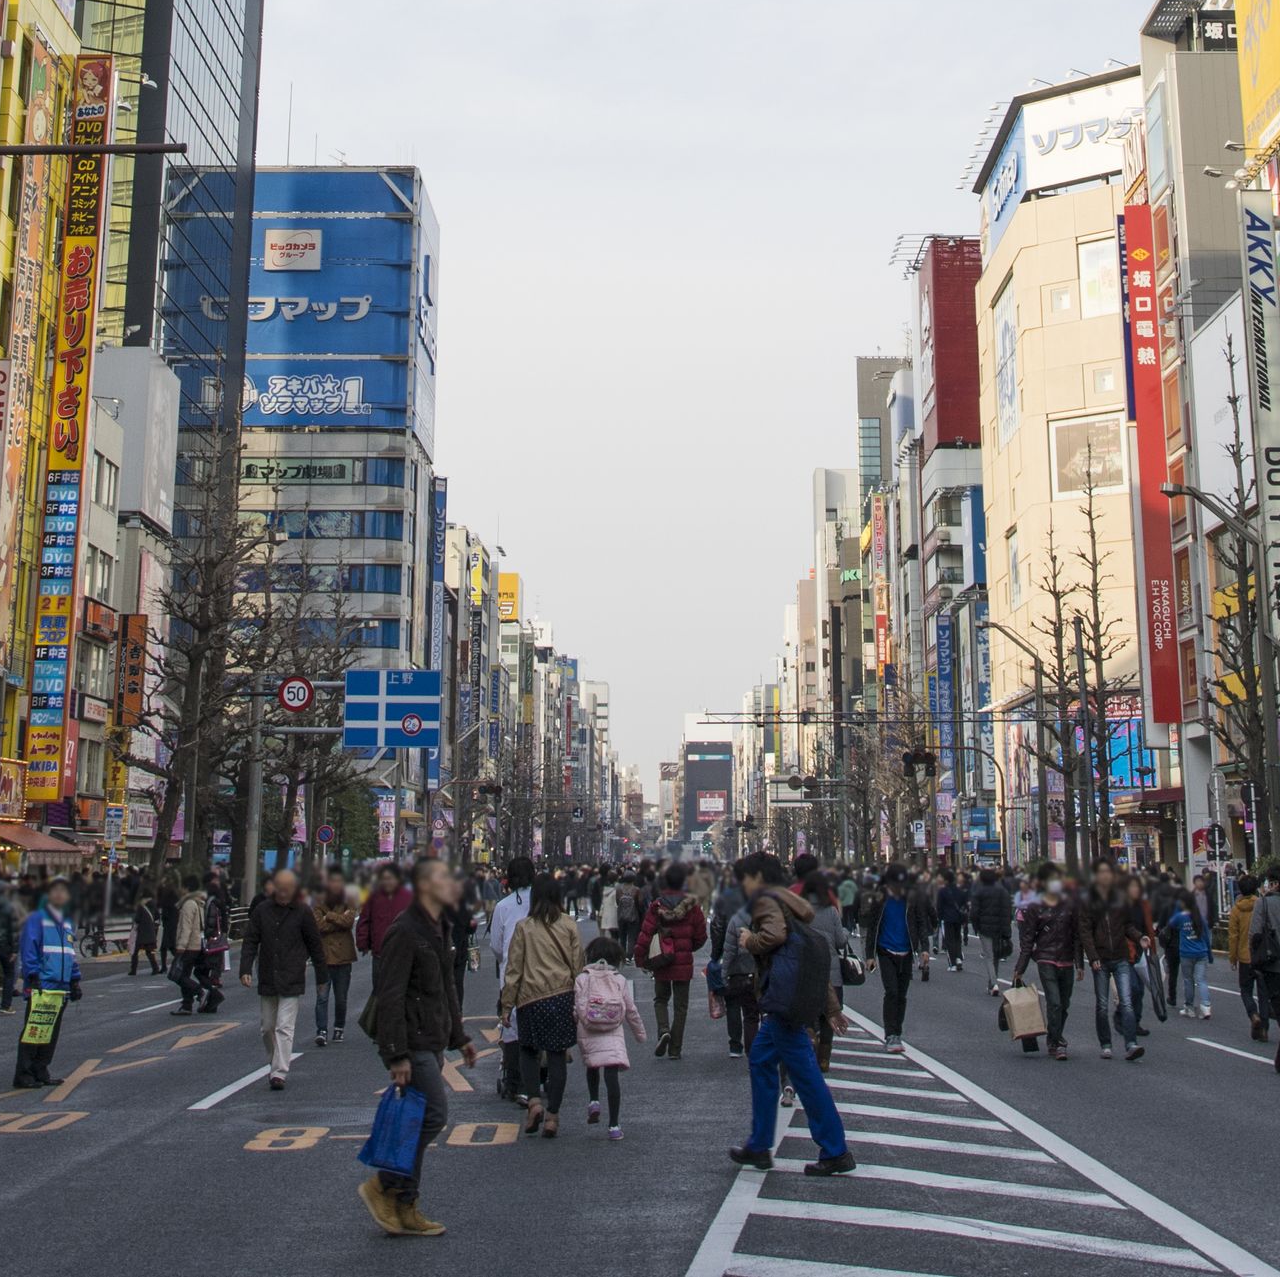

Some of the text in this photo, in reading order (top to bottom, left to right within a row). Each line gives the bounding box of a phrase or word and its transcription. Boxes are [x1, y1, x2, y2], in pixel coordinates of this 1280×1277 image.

[76, 104, 105, 118] あなたの
[77, 121, 103, 133] DVD
[1032, 108, 1144, 156] ソフマッ
[77, 159, 96, 171] CD
[73, 173, 100, 184] アイドル
[71, 185, 99, 197] アニメ
[71, 198, 97, 209] コミック
[70, 211, 95, 222] ホビー
[270, 243, 316, 251] ビックカメラ
[247, 294, 373, 322] フマップ
[1244, 208, 1277, 413] AKKY INTERNATIONAL
[1133, 270, 1156, 366] 坂口電熱
[53, 245, 93, 462] お売り下さい!!
[268, 377, 319, 394] アキバ
[261, 375, 364, 414] ソフマップ 1
[48, 472, 79, 483] 6F 中古
[49, 490, 76, 500] DVD
[46, 504, 77, 515] 5F 中古
[47, 521, 75, 532] DVD
[44, 535, 75, 546] 4F 中古
[44, 553, 73, 563] DVD
[41, 566, 72, 577] 3F 中古
[42, 584, 70, 595] DVD
[42, 597, 67, 610] 2F
[1160, 579, 1172, 641] SAKAGUCHI
[38, 631, 67, 643] フロア
[1153, 622, 1164, 652] CORP.
[36, 647, 67, 659] 1F 中古
[938, 629, 951, 674] ソフマップ
[34, 663, 65, 675] TVゲーム
[128, 644, 141, 695] 吉野家
[388, 672, 413, 685] 上野
[34, 679, 64, 691] DVD
[287, 686, 307, 702] 50
[32, 695, 64, 707] B1F 中古
[30, 712, 63, 724] PCゲーム
[30, 744, 59, 756] ムーラン
[28, 759, 58, 772] AKIBA
[243, 1122, 522, 1152] 8-0
